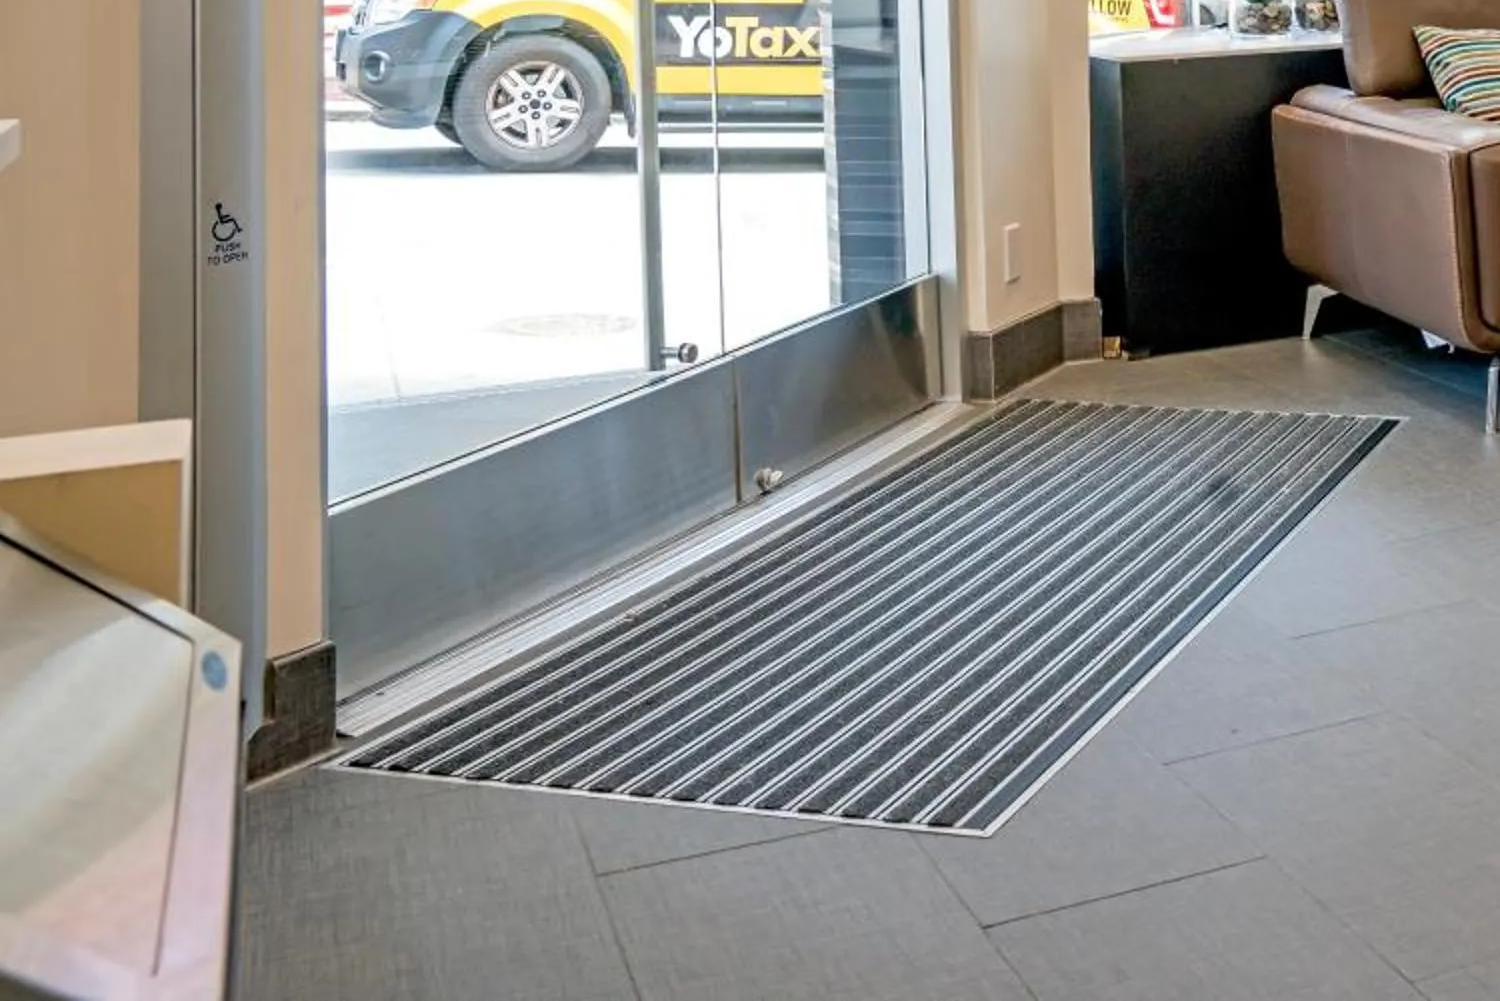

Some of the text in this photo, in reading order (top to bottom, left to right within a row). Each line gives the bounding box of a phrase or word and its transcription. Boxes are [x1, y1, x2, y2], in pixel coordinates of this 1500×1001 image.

[666, 14, 822, 59] YoTax
[207, 251, 248, 266] TO OPEN
